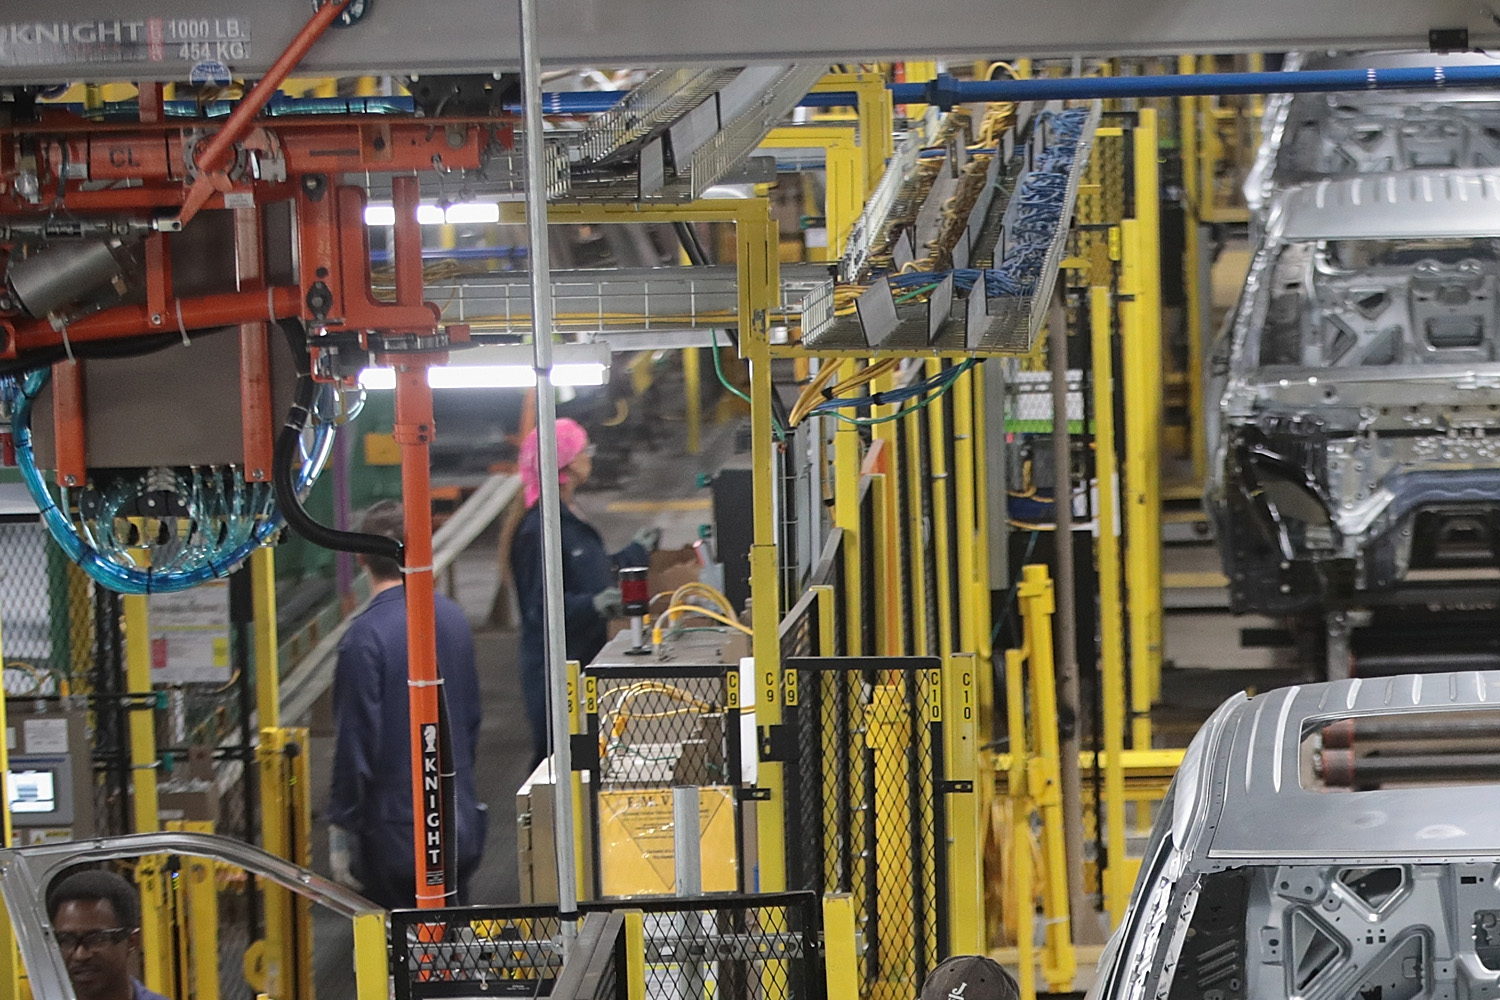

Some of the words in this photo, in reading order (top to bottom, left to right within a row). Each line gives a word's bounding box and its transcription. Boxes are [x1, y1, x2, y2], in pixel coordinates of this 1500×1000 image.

[11, 20, 144, 44] KNIGHT
[169, 18, 210, 38] 1000
[215, 18, 245, 38] LB.
[179, 41, 211, 60] 454
[217, 42, 250, 60] KG.
[109, 146, 141, 168] CL
[586, 680, 595, 711] C8
[729, 674, 737, 706] C9
[765, 672, 774, 702] C9
[787, 672, 795, 702] C9
[931, 671, 939, 719] C10
[962, 672, 971, 720] C10
[424, 757, 441, 864] KNIGHT
[951, 982, 967, 996] J
